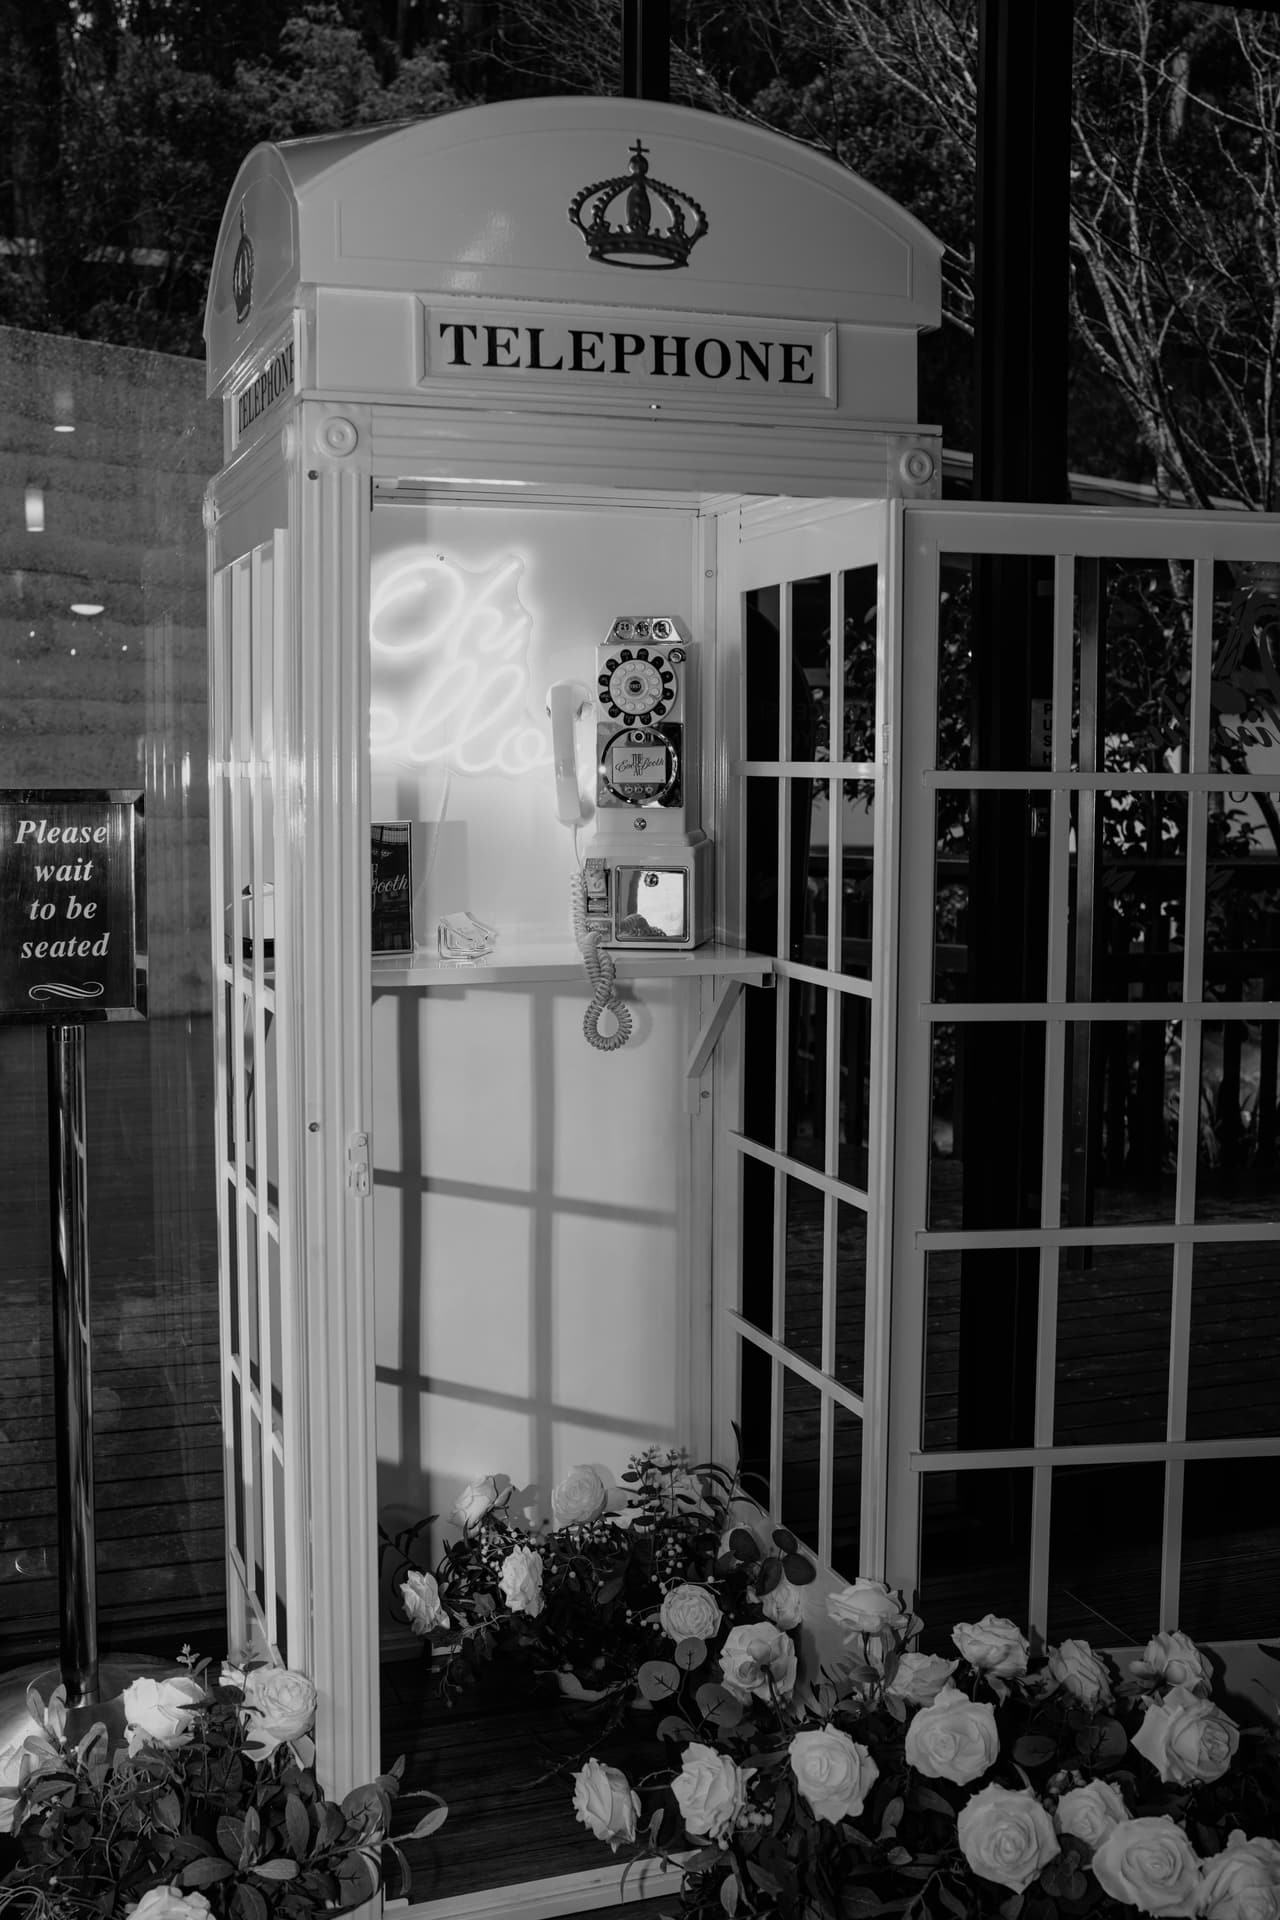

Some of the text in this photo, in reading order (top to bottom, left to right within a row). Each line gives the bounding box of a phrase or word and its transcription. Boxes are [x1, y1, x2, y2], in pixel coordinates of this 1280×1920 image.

[439, 322, 815, 385] TELEPHONE
[14, 819, 107, 845] Please
[34, 857, 95, 882] wait
[29, 895, 97, 920] to be
[21, 932, 110, 959] seated
